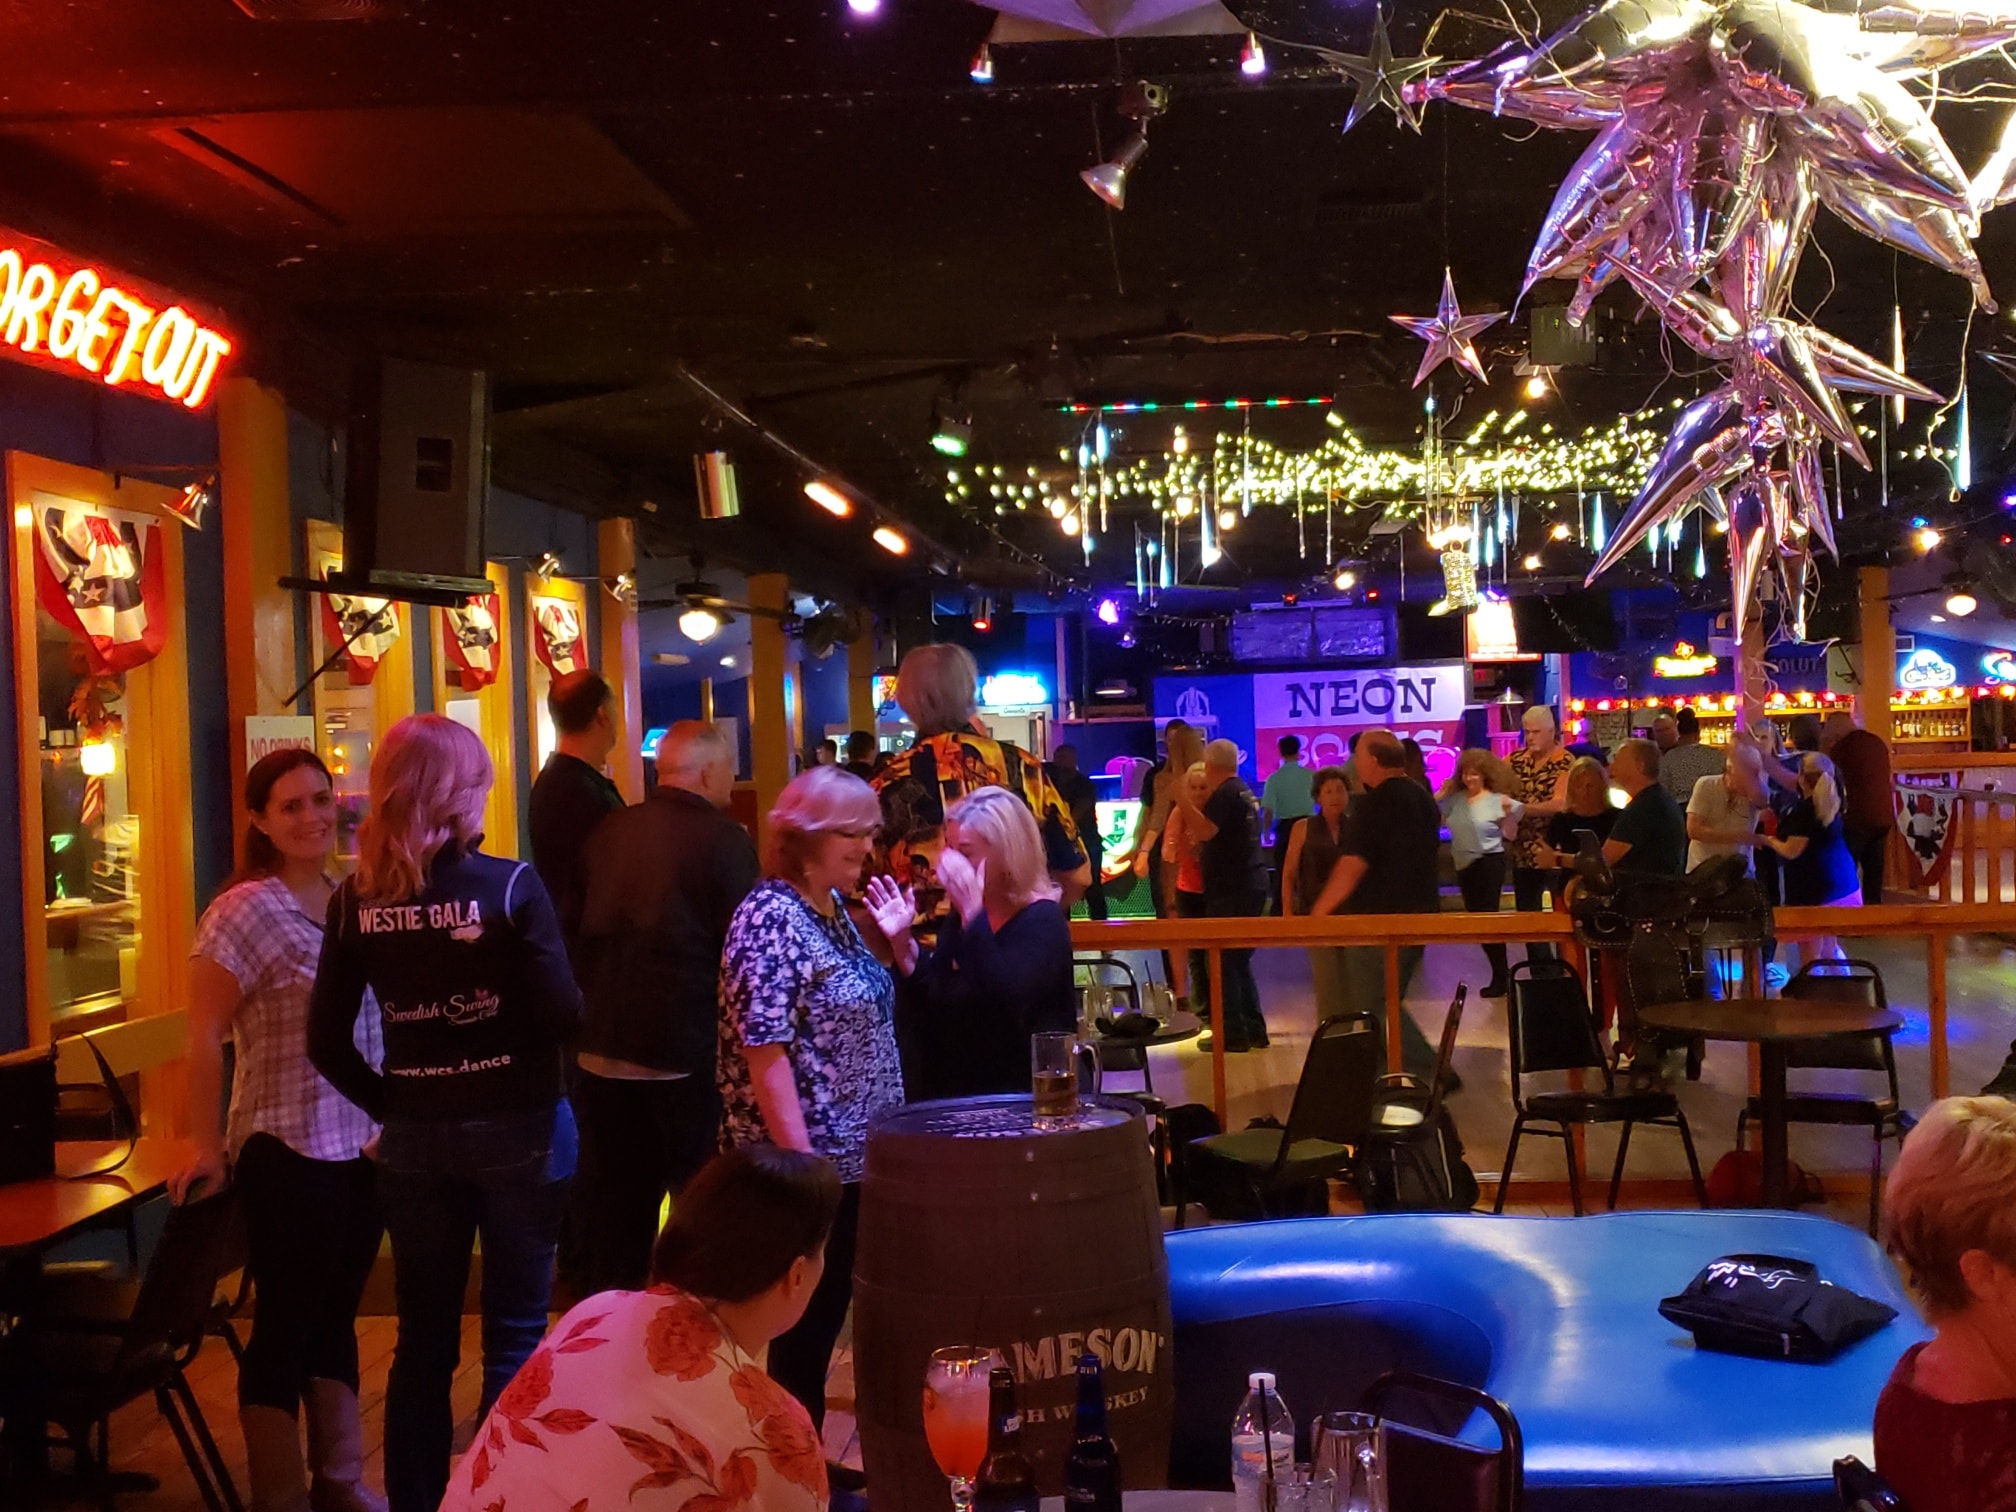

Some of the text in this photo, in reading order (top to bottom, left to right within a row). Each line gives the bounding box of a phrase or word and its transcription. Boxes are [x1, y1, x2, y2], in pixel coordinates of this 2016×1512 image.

[1286, 677, 1436, 718] NEON
[251, 738, 267, 761] NO
[358, 900, 481, 934] WESTIE GALA
[384, 1002, 440, 1022] Swedish
[443, 994, 500, 1017] Swing
